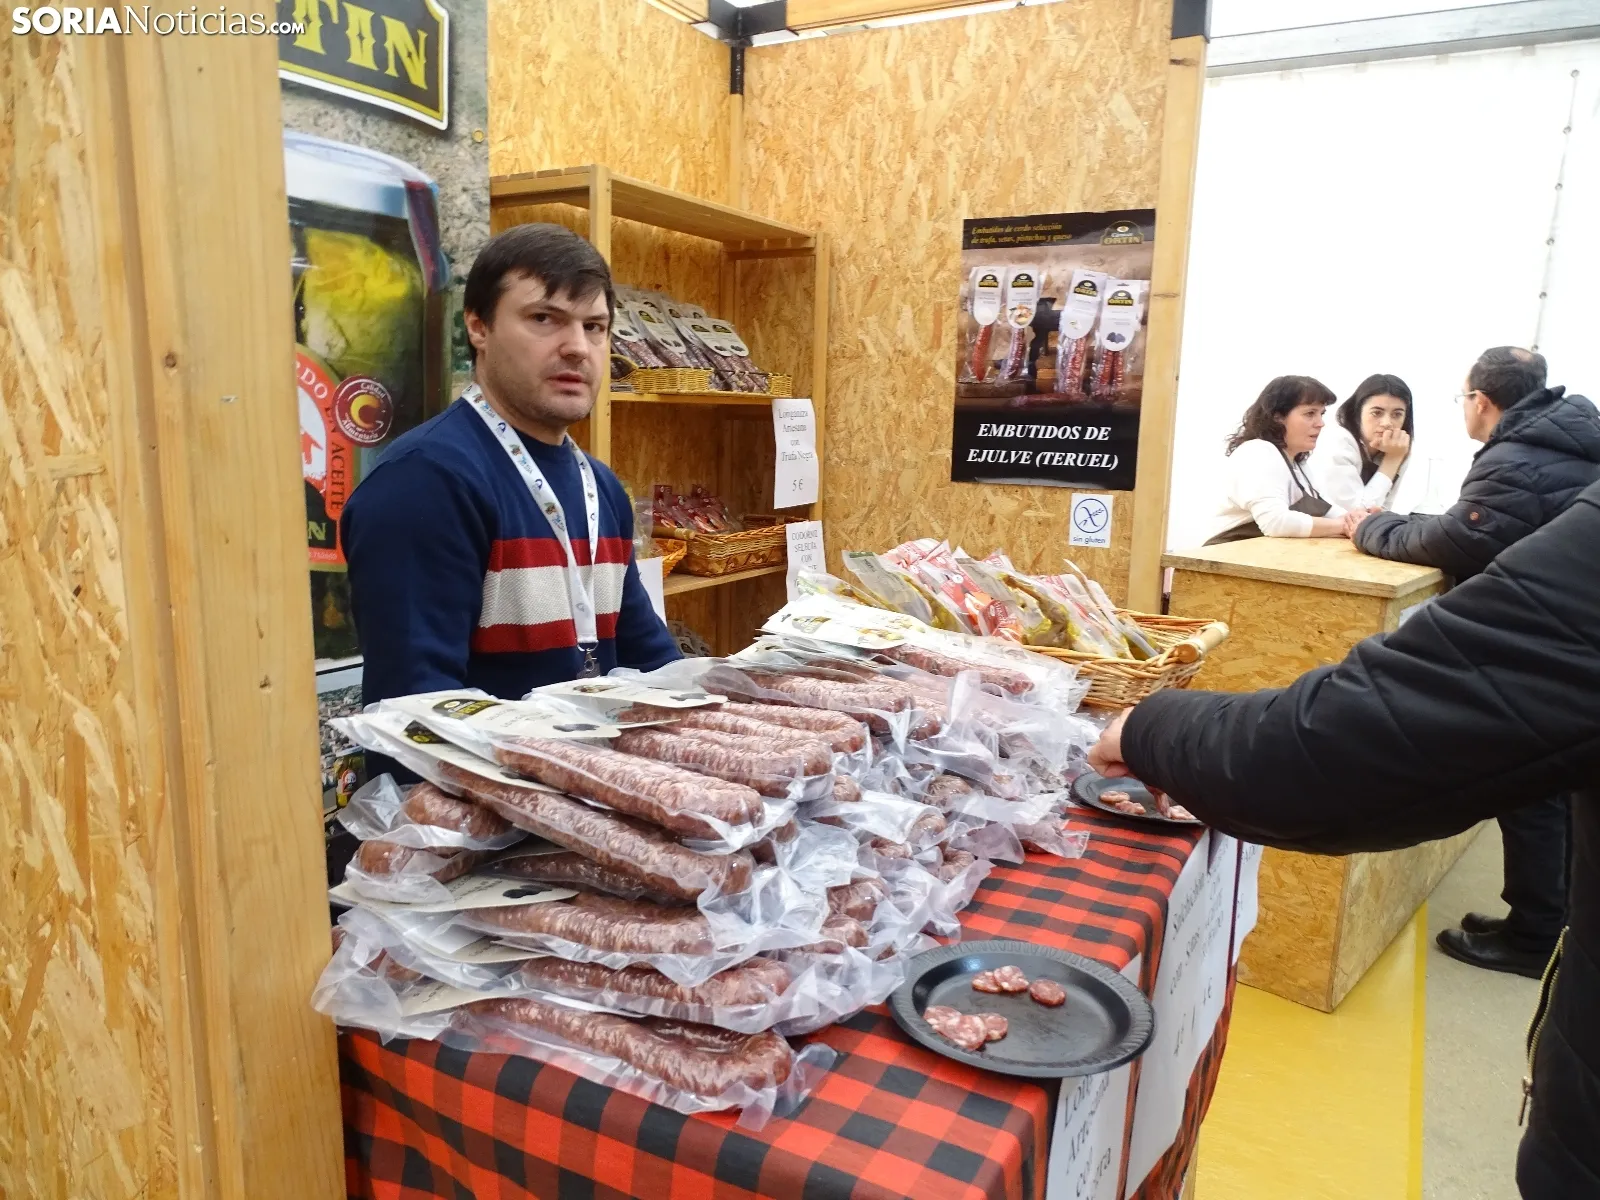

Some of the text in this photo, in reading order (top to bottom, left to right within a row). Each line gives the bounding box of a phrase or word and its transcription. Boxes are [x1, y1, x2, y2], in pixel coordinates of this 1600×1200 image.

[291, 0, 429, 90] TIN
[977, 423, 1111, 441] EMBUTIDOS DE
[966, 448, 1119, 470] EJULVE (TERUEL)
[331, 441, 346, 511] ACEITE
[792, 478, 804, 491] 5 €
[1072, 535, 1106, 545] sin gluten
